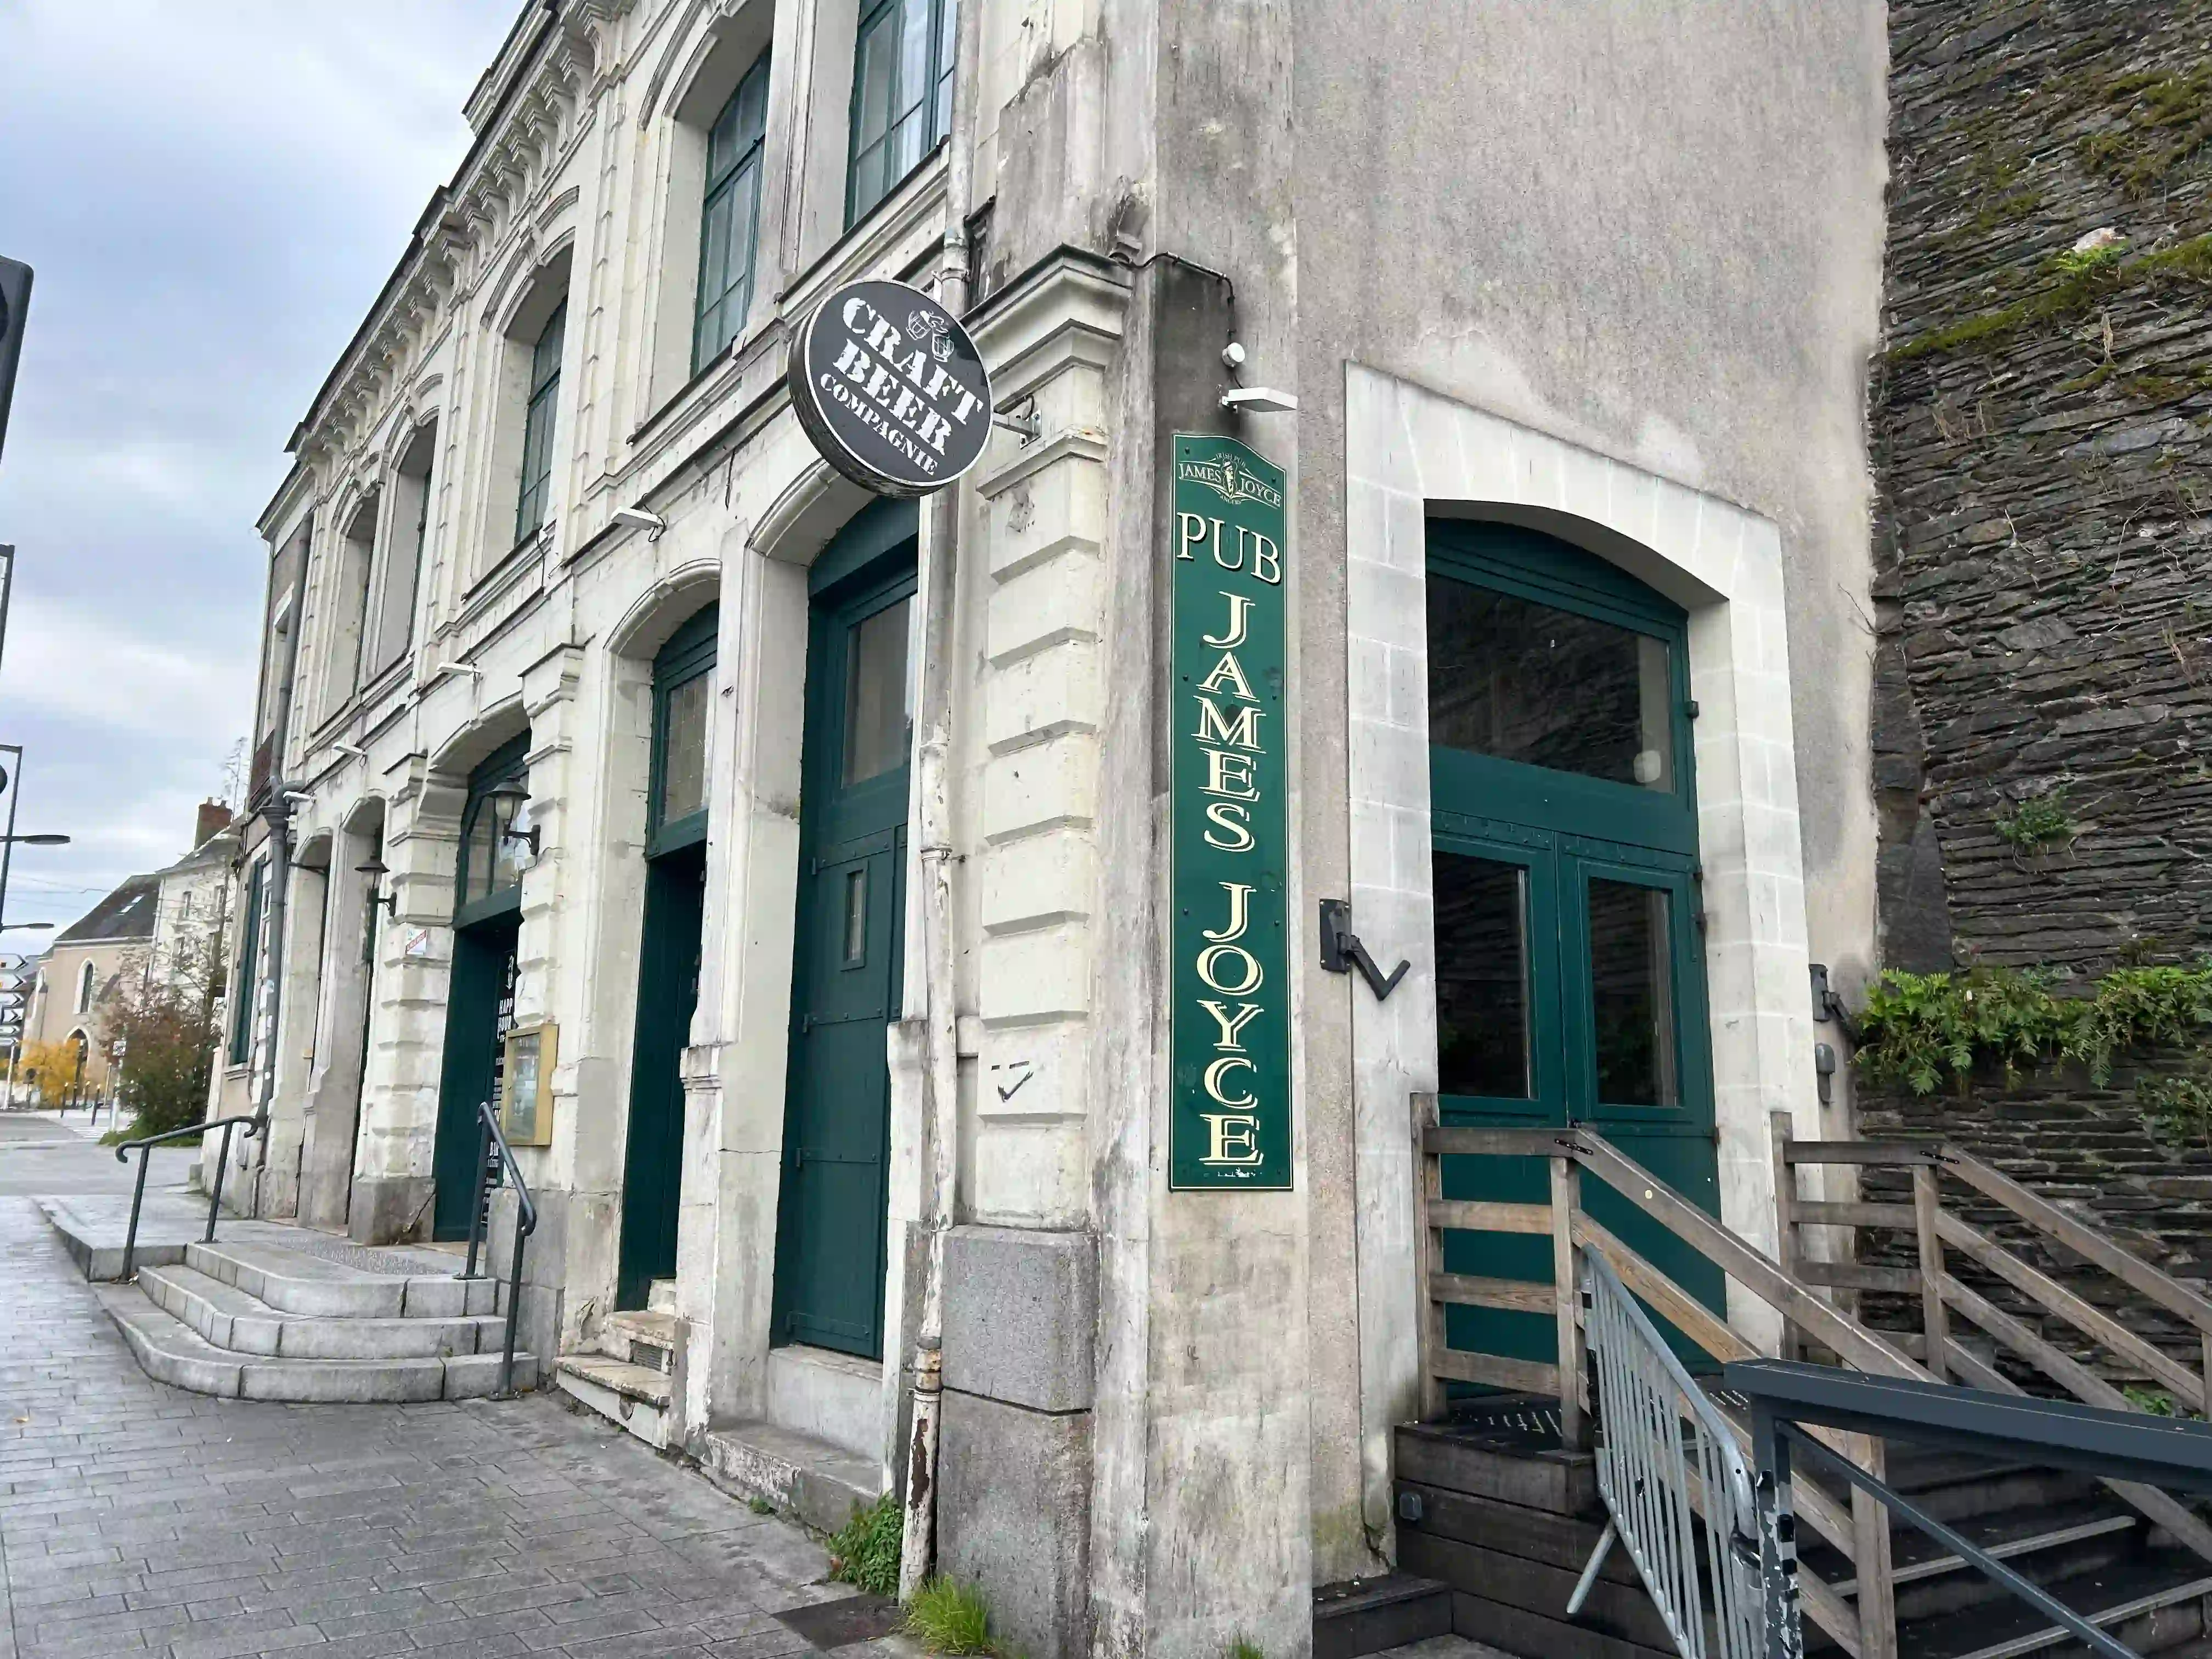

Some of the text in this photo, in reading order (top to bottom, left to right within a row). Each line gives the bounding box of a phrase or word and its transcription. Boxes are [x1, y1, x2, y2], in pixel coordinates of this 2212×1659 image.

[832, 338, 952, 456] BEER
[842, 297, 984, 425] CRAFT
[820, 373, 938, 476] COMPAGNIE
[1178, 462, 1282, 507] JAMES JOYCE
[1177, 511, 1282, 584] PUB
[1190, 590, 1266, 853] JAMES
[1196, 881, 1265, 1166] JOYCE
